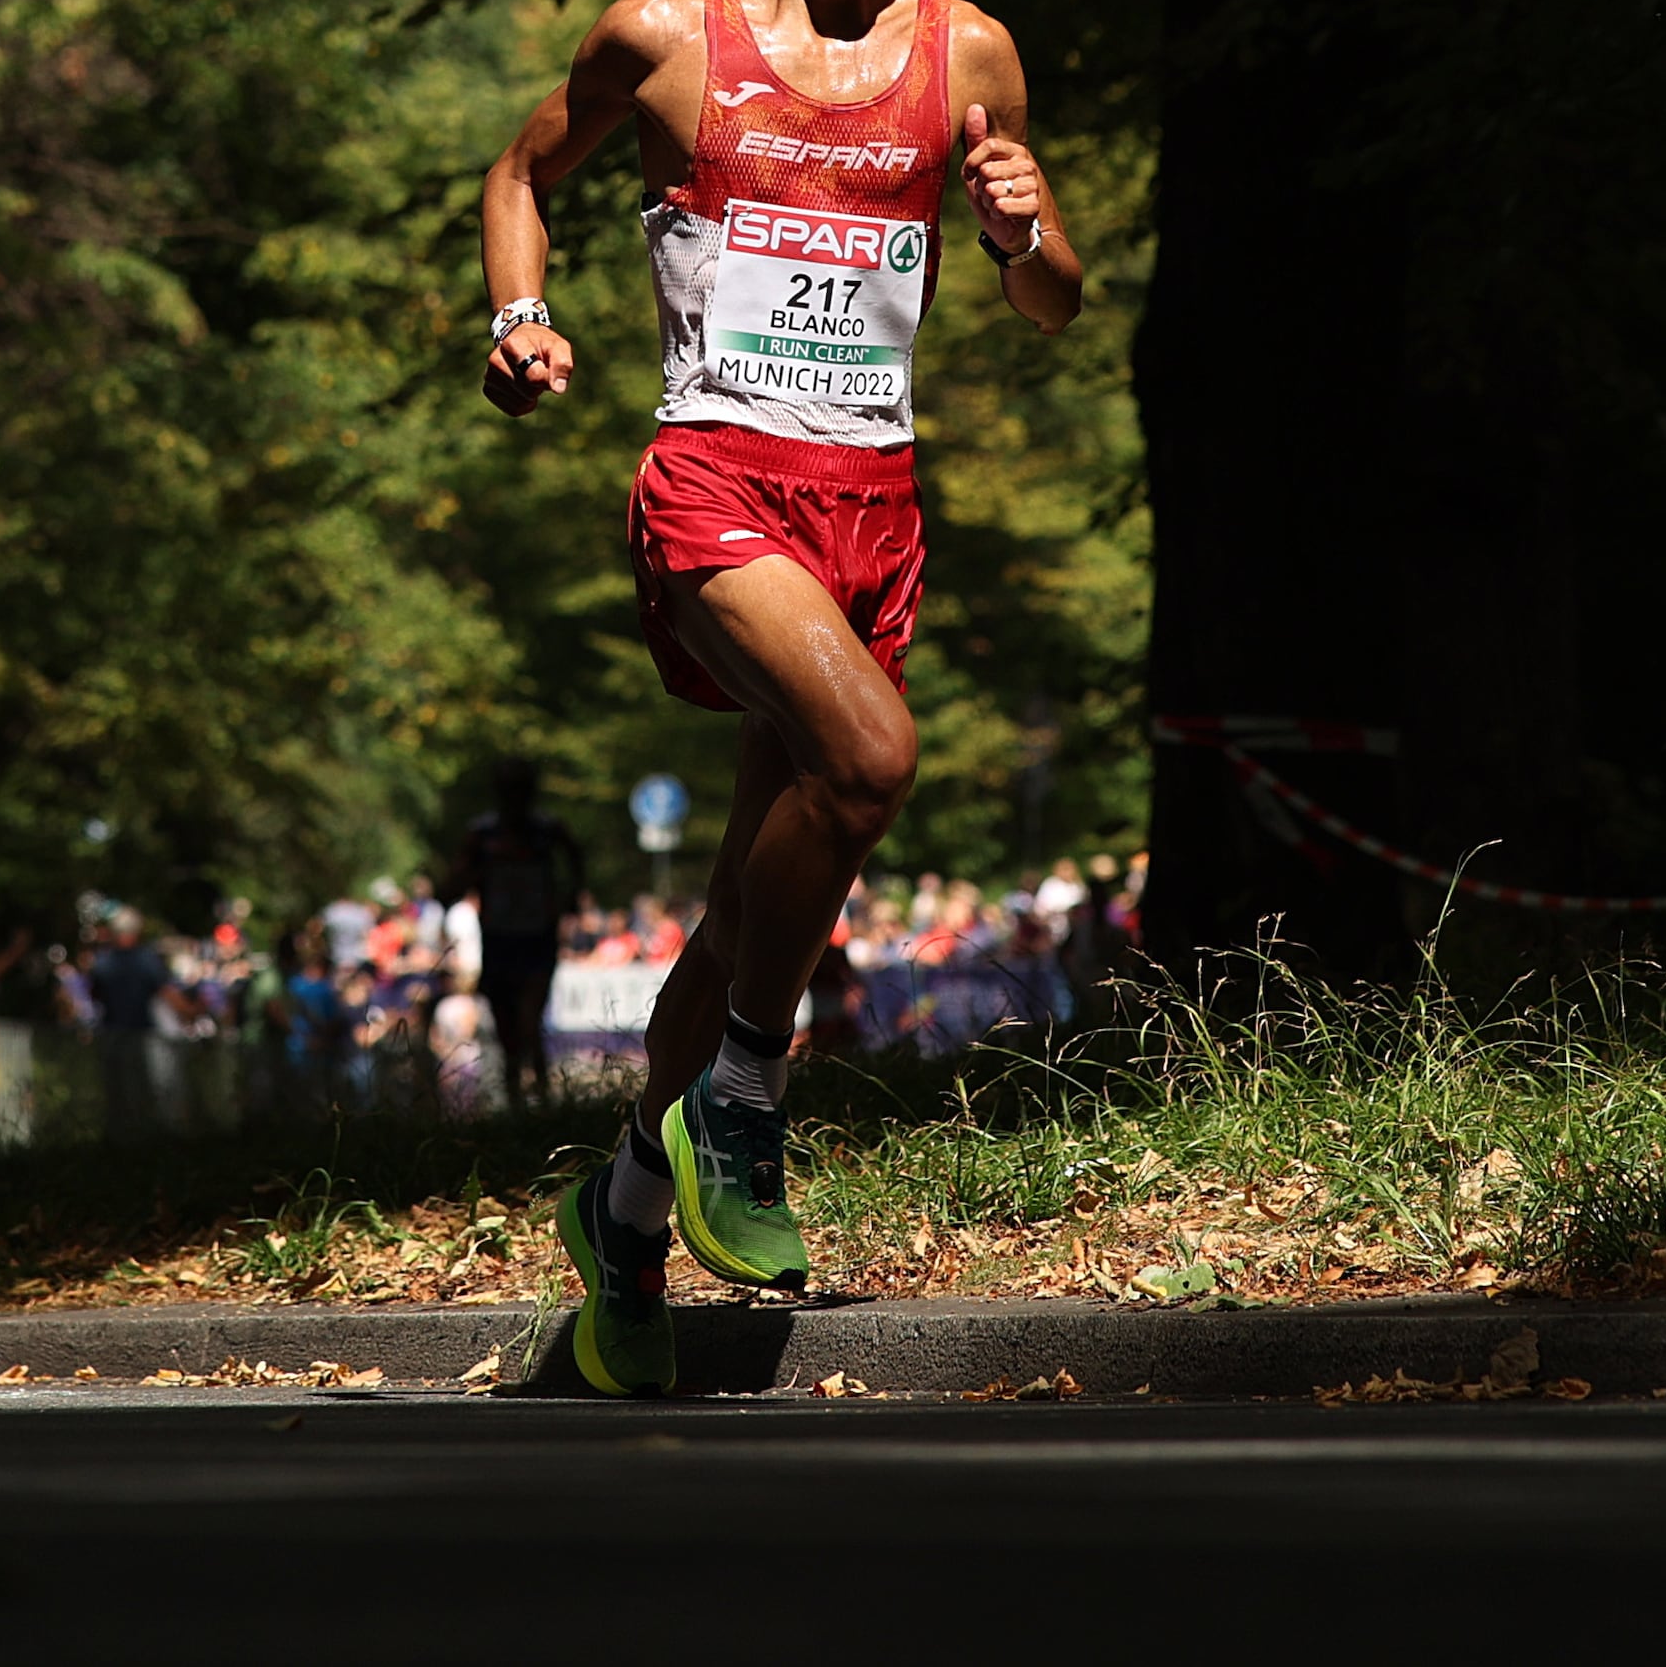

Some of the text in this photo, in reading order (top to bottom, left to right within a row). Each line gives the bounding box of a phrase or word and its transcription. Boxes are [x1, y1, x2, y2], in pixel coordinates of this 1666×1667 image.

[735, 130, 920, 172] ESPAÑA
[732, 213, 880, 263] SPAR
[786, 273, 863, 314] 217
[770, 309, 865, 337] BLANCO
[759, 337, 765, 352] I
[770, 340, 810, 358] RUN
[717, 357, 894, 396] MUNICH 2022
